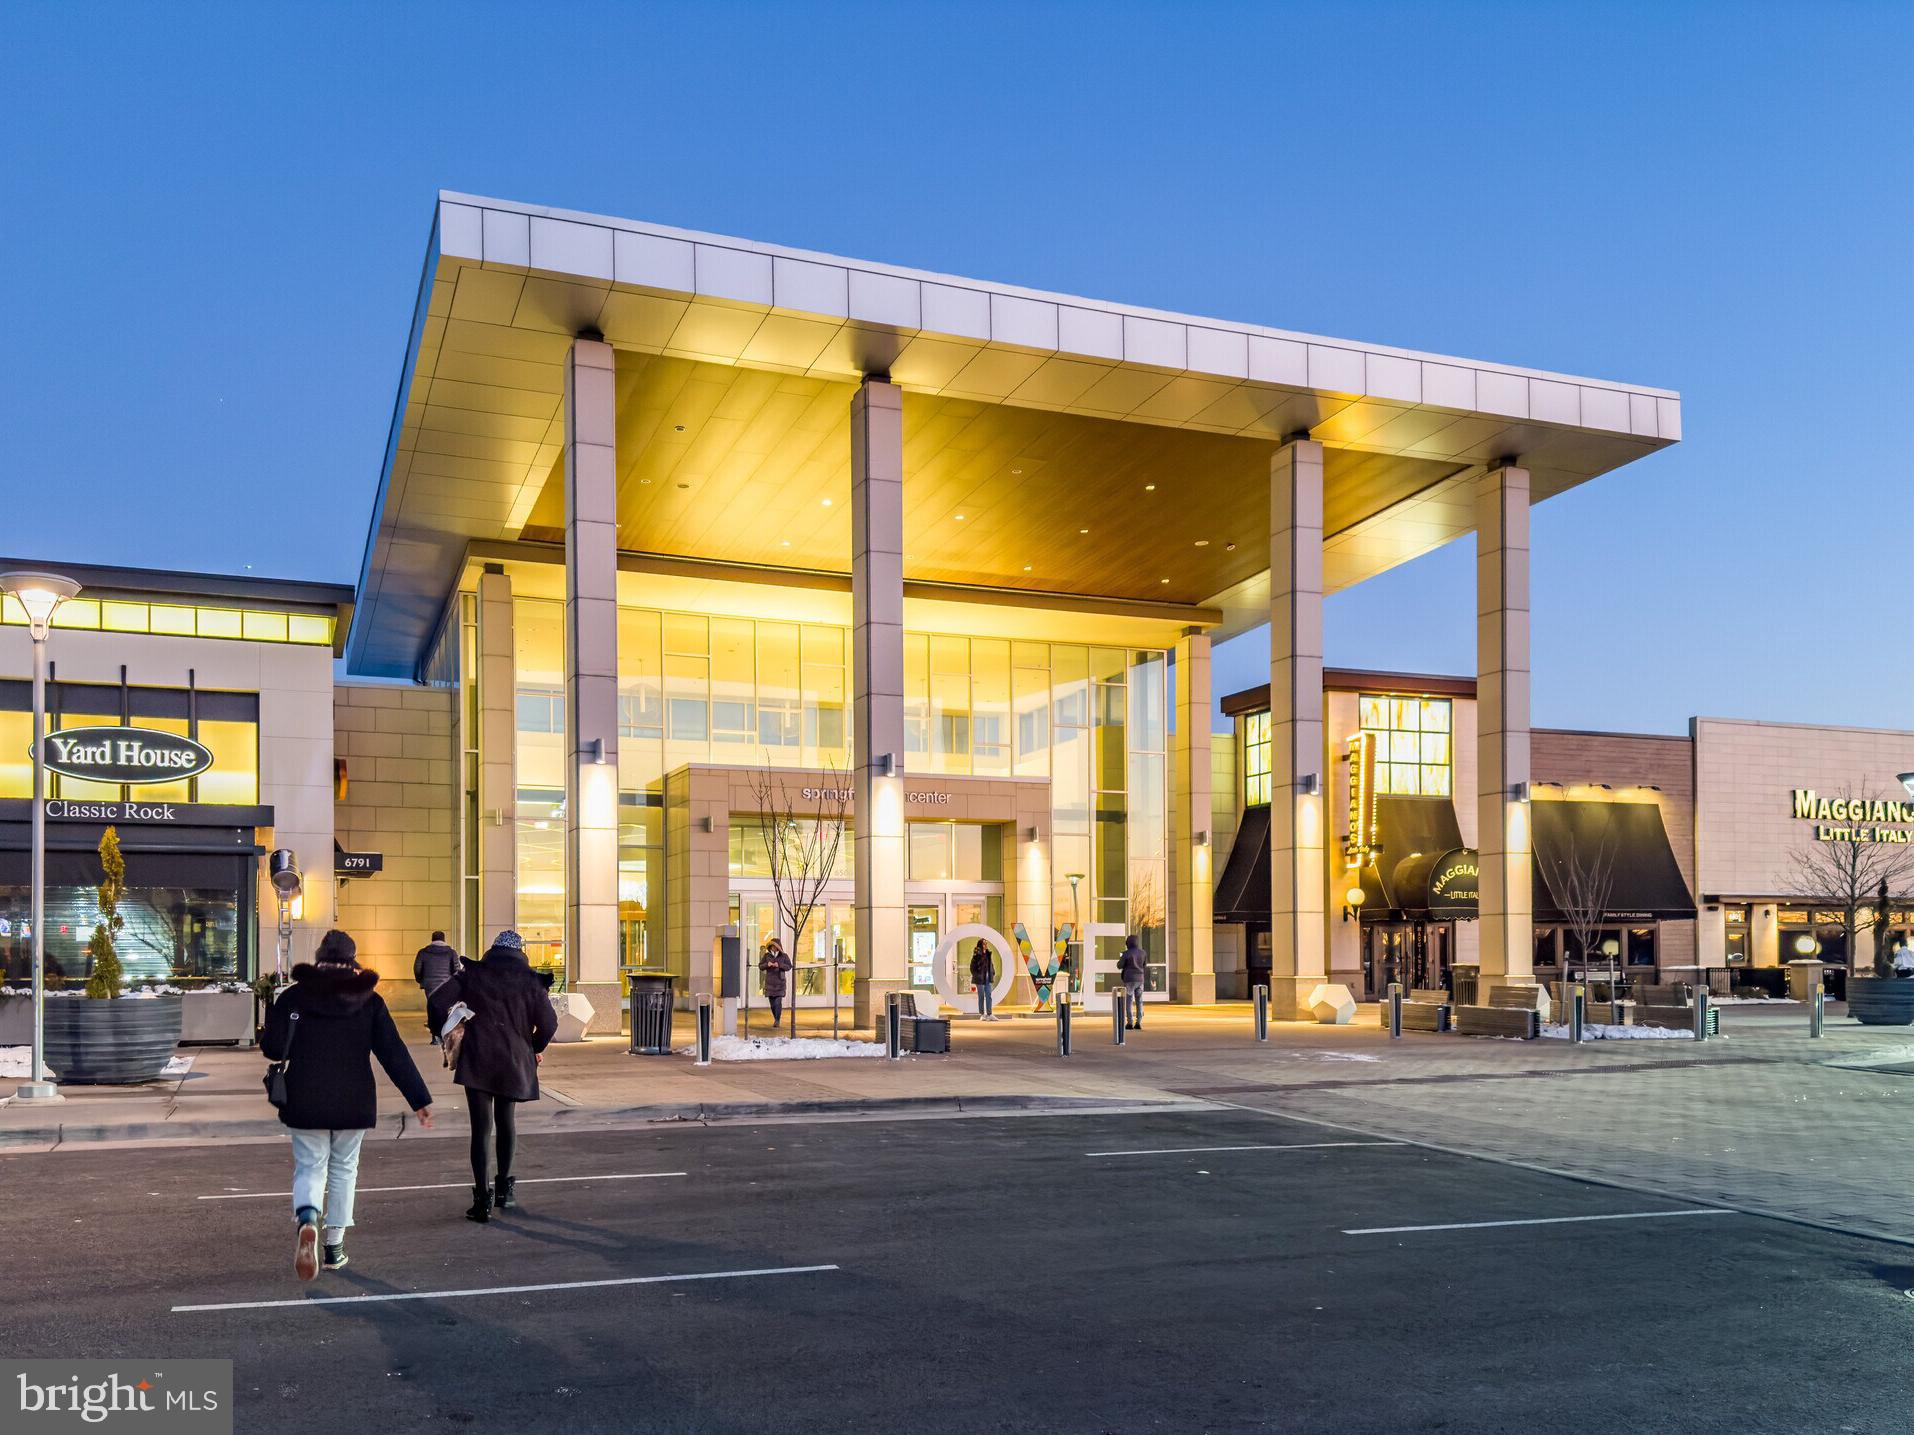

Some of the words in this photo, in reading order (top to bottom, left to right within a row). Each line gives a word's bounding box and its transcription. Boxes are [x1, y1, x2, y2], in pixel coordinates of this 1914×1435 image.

[52, 738, 112, 764] Yard
[116, 741, 196, 768] House
[802, 786, 855, 802] springf
[45, 801, 117, 818] Classic
[124, 803, 176, 820] Rock
[1818, 825, 1869, 841] LITTLE
[1875, 827, 1913, 843] ITALY
[344, 858, 370, 867] 6791
[1432, 864, 1480, 895] MAGGIA
[1450, 891, 1468, 900] LITTLE
[932, 923, 1126, 1013] OVE
